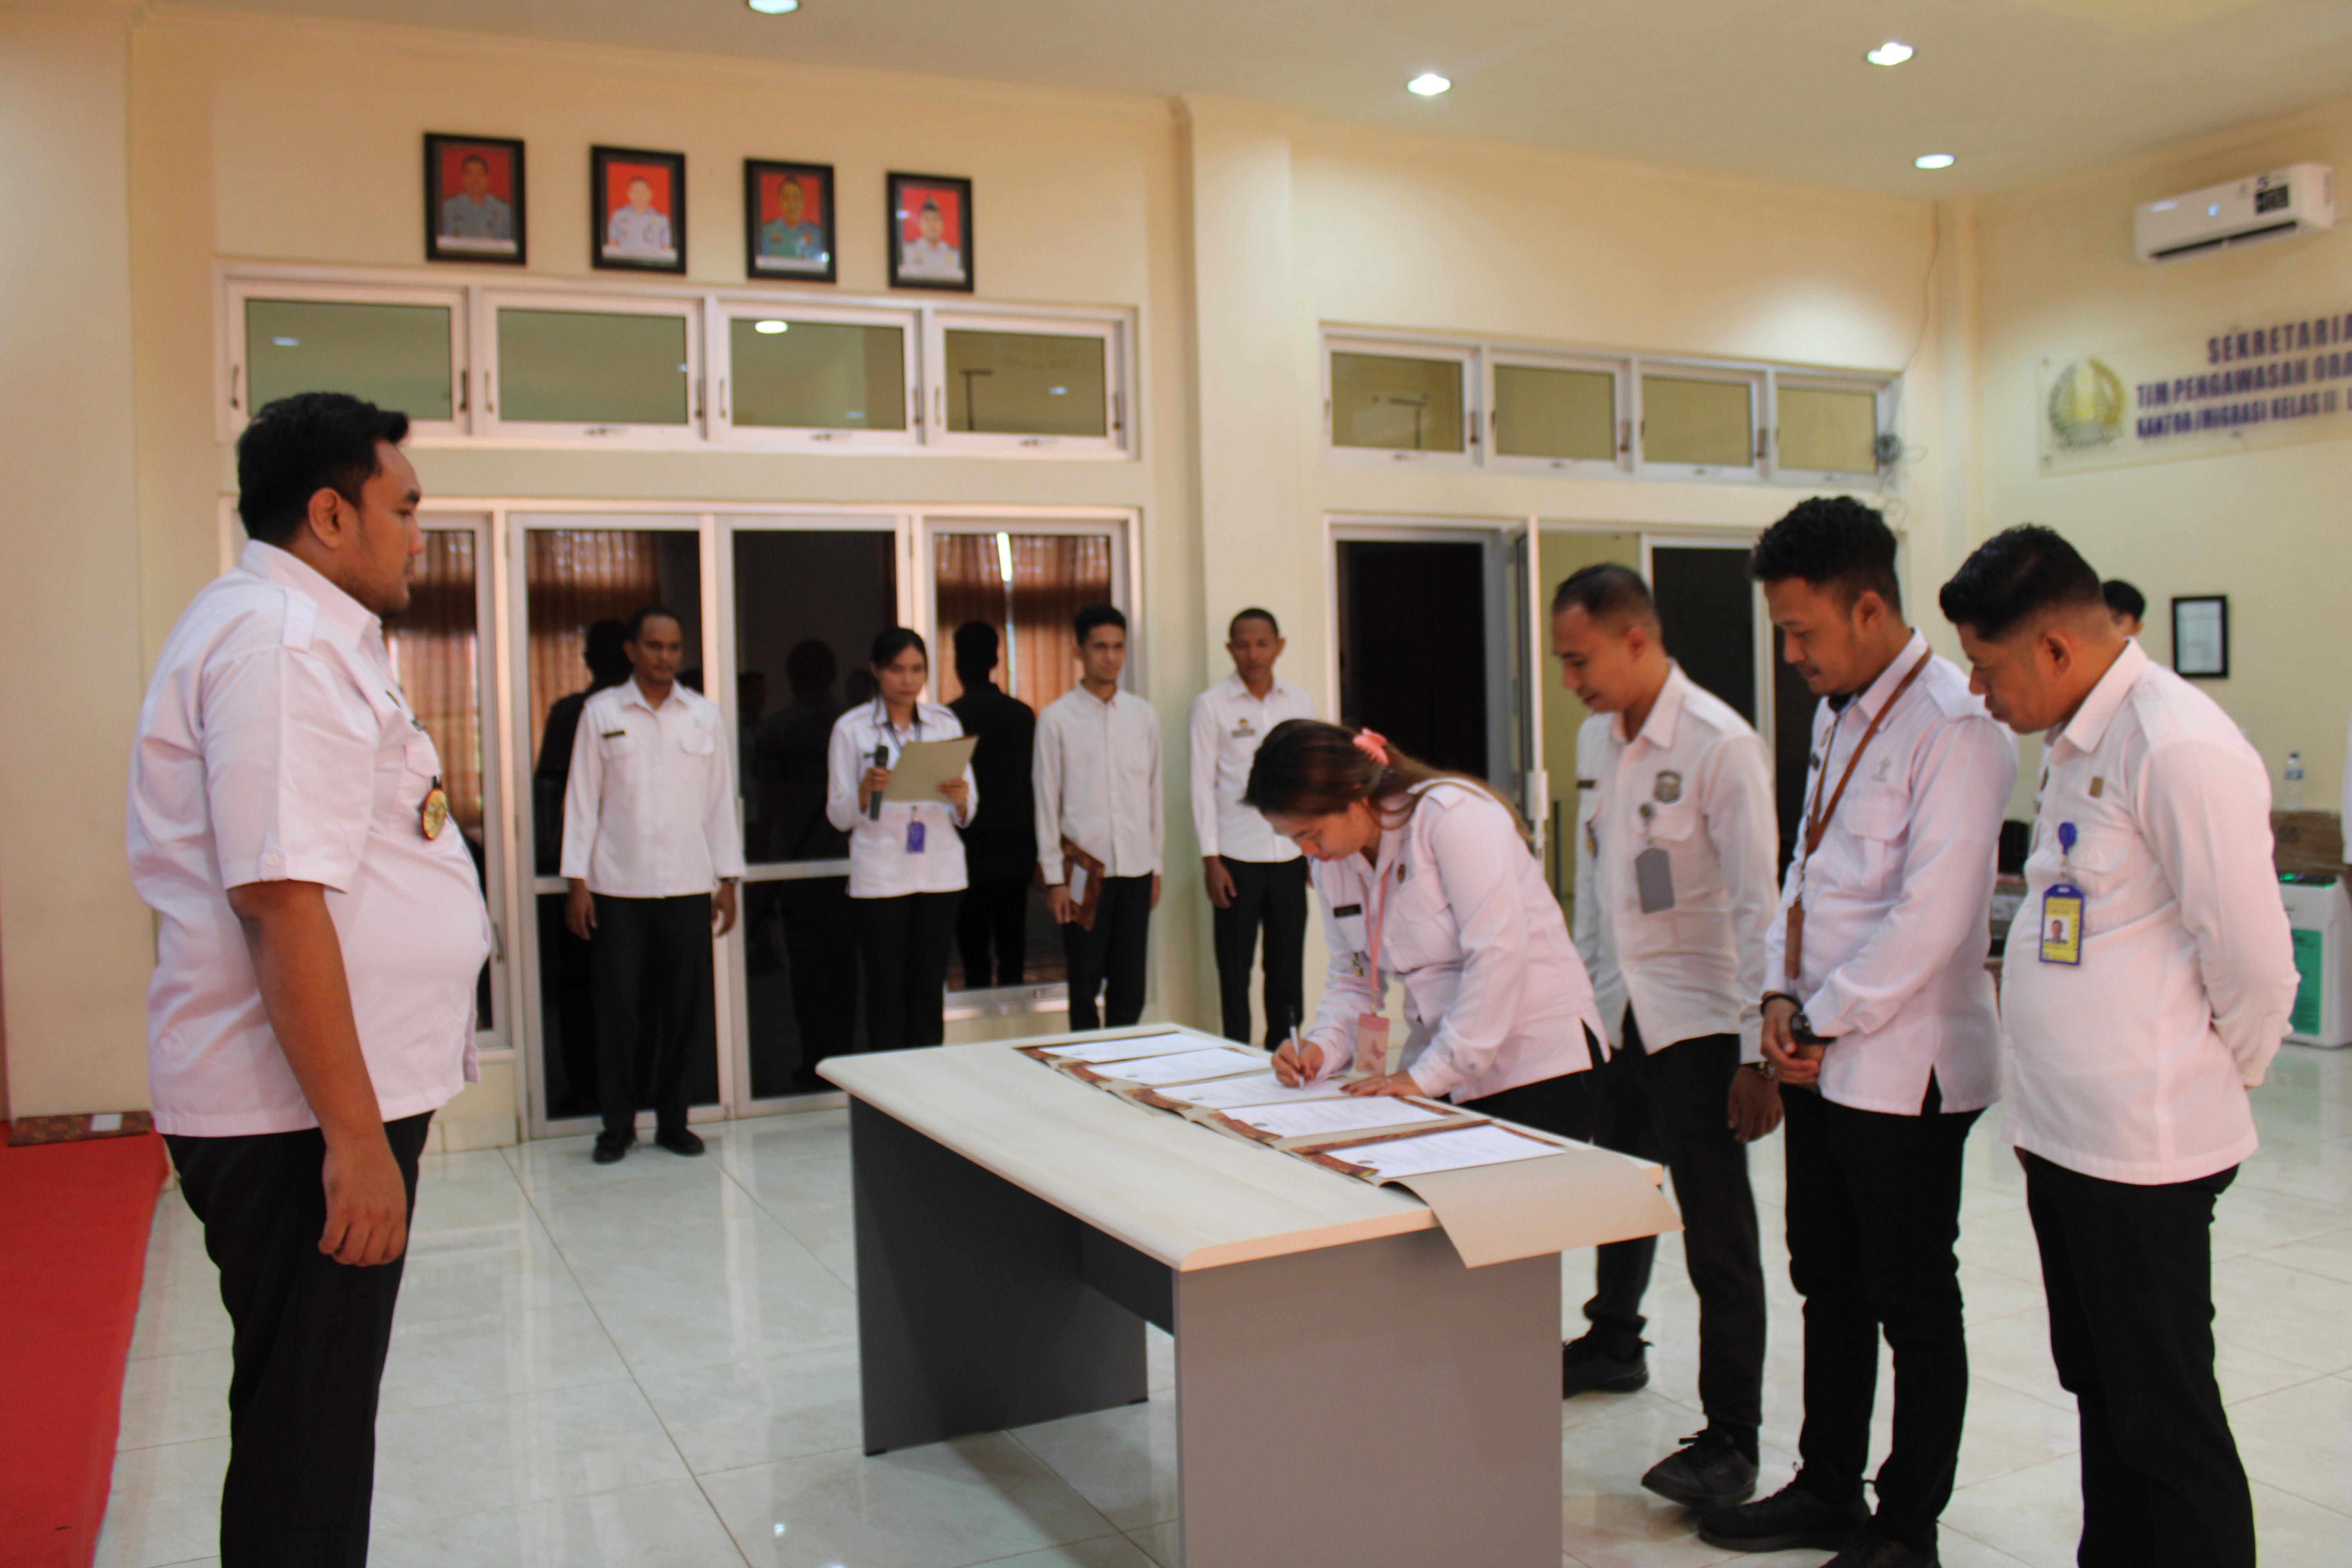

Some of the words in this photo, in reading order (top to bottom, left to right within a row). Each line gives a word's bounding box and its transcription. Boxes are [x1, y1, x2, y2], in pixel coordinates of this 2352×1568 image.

[2136, 382, 2168, 407] TIM
[2173, 358, 2307, 402] PENGAWASAN
[2272, 392, 2319, 419] KELAS
